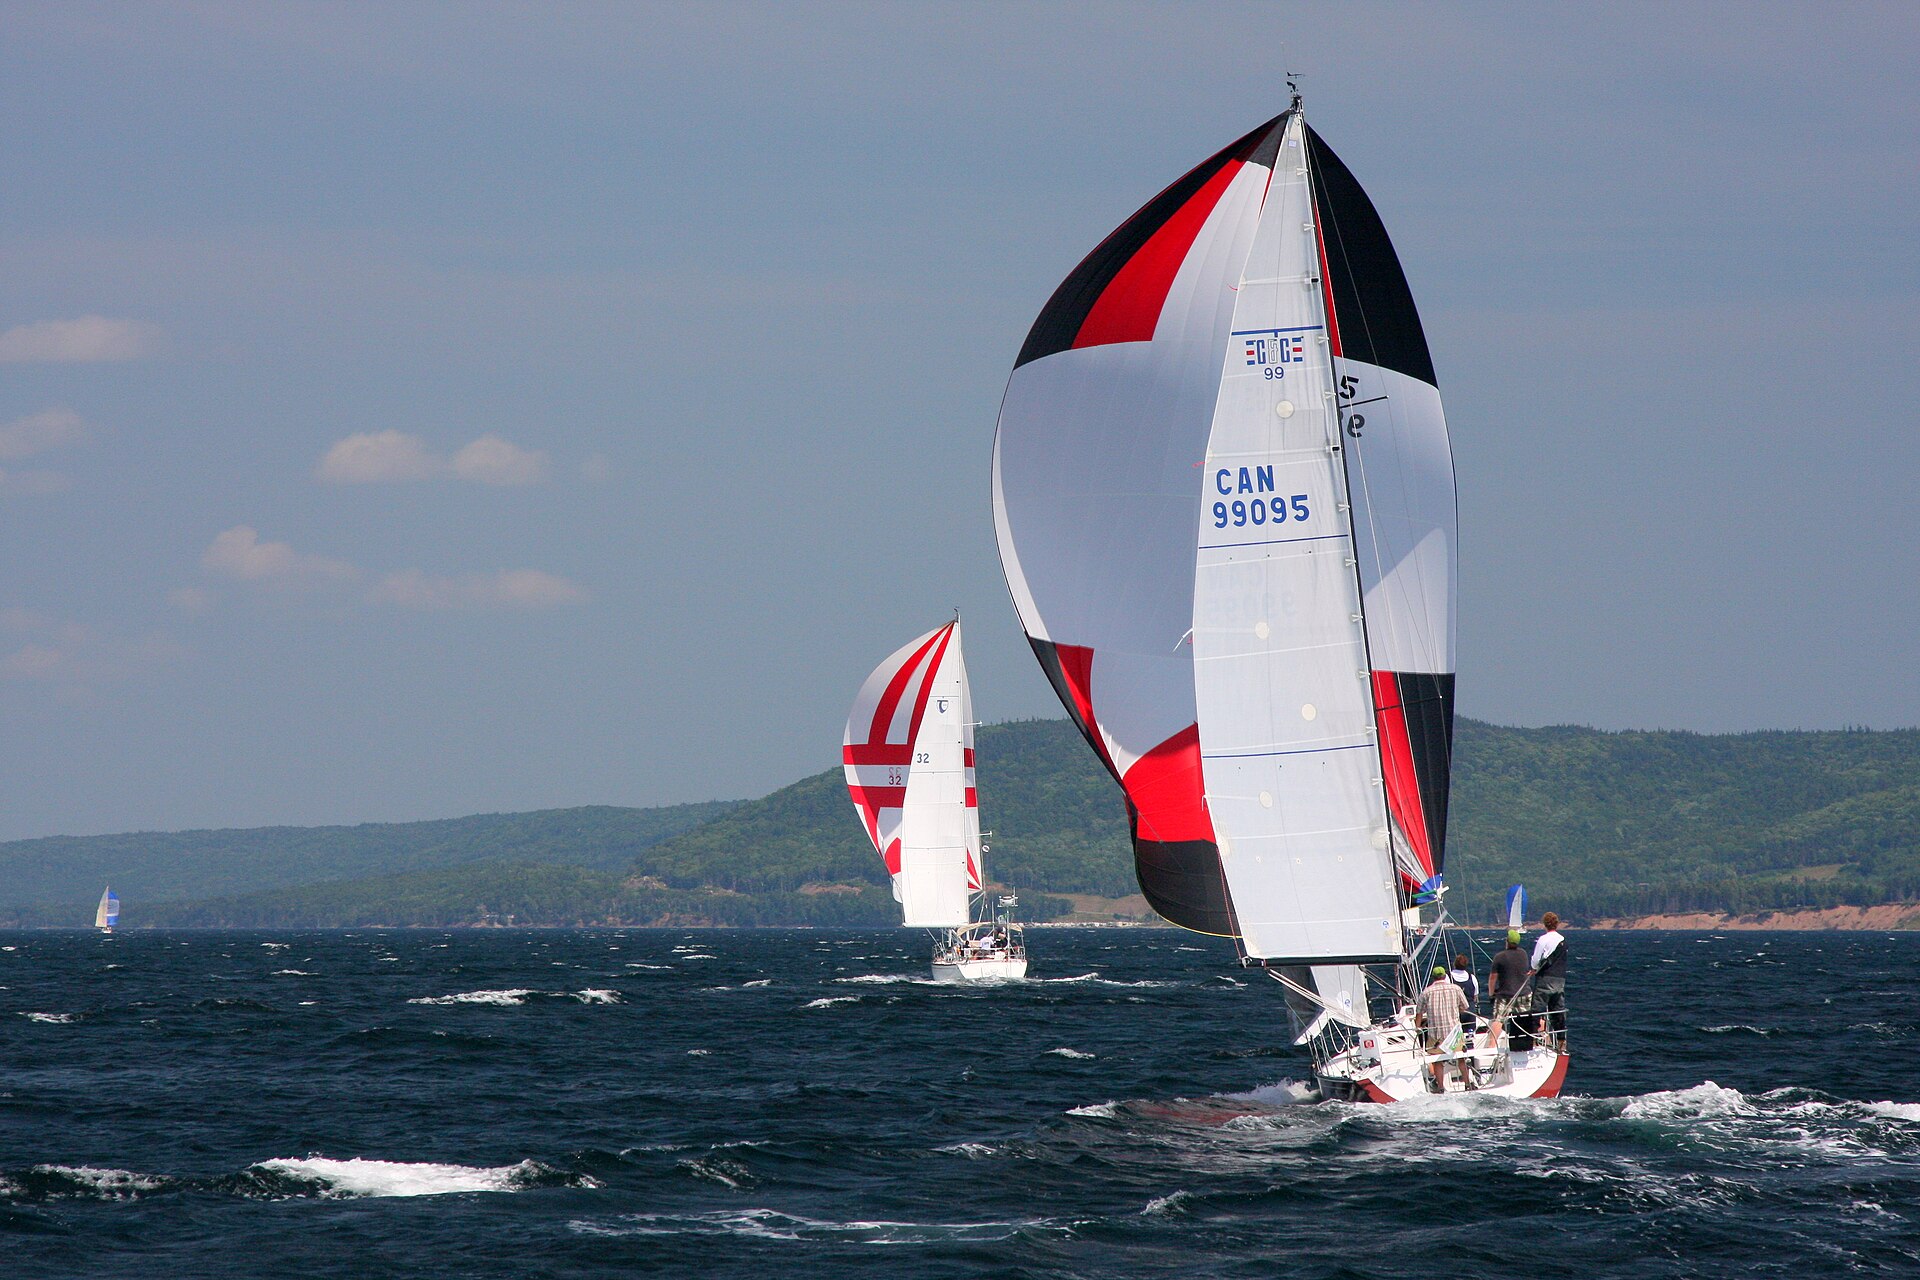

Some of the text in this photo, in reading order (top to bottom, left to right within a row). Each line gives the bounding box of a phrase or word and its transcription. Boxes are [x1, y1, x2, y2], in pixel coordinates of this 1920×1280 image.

[1263, 366, 1285, 380] 99
[1216, 464, 1275, 496] CAN
[1212, 494, 1310, 529] 99095
[916, 752, 930, 764] 32
[888, 775, 902, 786] 32
